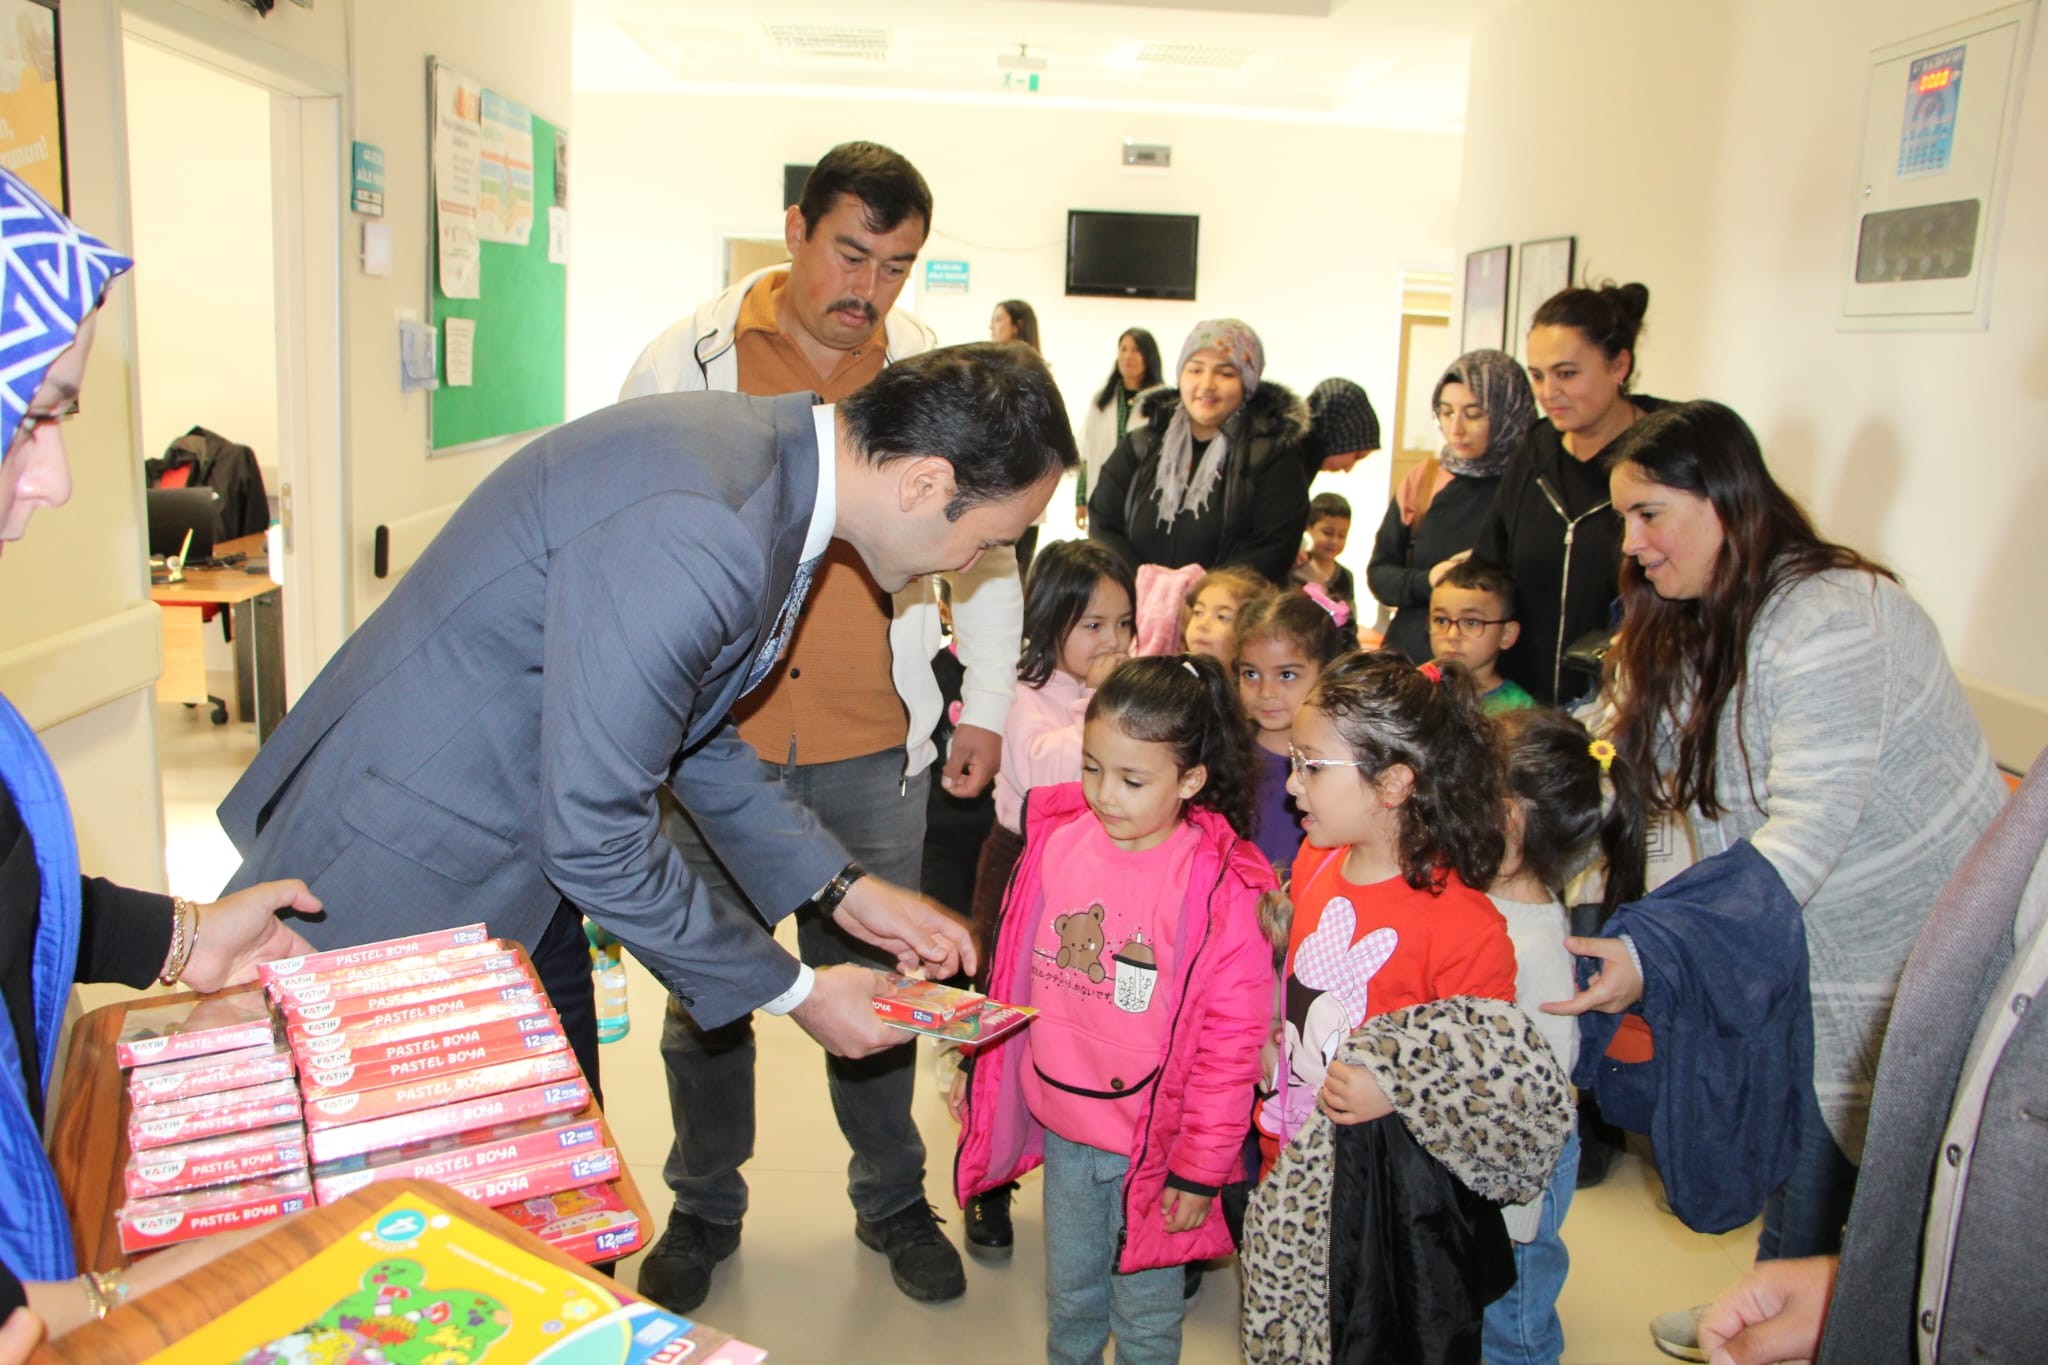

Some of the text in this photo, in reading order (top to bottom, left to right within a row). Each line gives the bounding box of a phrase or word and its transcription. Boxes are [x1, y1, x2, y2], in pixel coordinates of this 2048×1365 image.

[453, 932, 467, 943] 12
[336, 951, 383, 966] PASTEL
[386, 942, 419, 956] BOYA
[501, 988, 515, 1000] 12
[374, 1000, 464, 1025] PASTEL BOYA
[913, 1010, 922, 1020] 12
[518, 1018, 534, 1032] 12
[175, 1037, 215, 1050] PASTEL
[386, 1031, 480, 1059] PASTEL BOYA
[525, 1035, 541, 1048] 12
[390, 1048, 486, 1076] PASTEL BOYA
[191, 1073, 233, 1085] PASTEL
[396, 1082, 450, 1103] PASTEL
[545, 1089, 561, 1103] 12
[463, 1102, 504, 1120] BOYA
[193, 1109, 269, 1131] PASTEL BOYA
[559, 1132, 577, 1146] 12
[279, 1149, 290, 1161] 12
[414, 1146, 518, 1179] PASTEL BOYA
[192, 1153, 275, 1176] PASTEL BOYA
[572, 1161, 591, 1177] 12
[486, 1177, 529, 1197] BOYA
[282, 1200, 296, 1212] 12
[191, 1204, 278, 1230] PASTEL BOYA
[597, 1234, 615, 1249] 12
